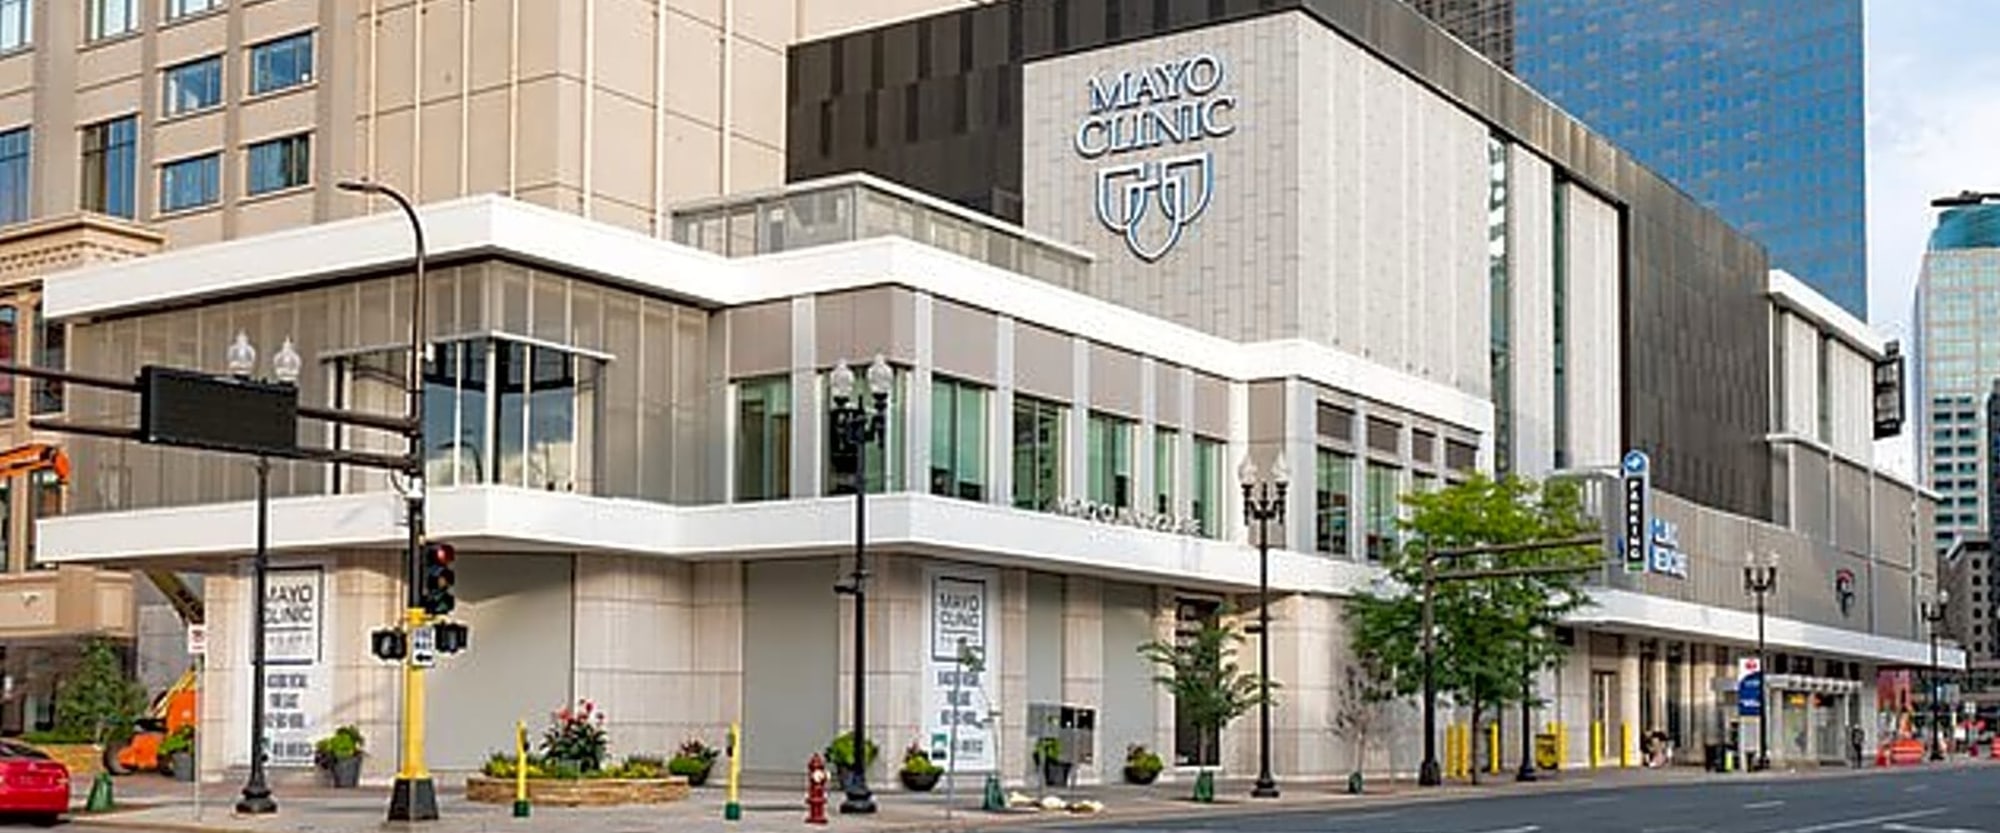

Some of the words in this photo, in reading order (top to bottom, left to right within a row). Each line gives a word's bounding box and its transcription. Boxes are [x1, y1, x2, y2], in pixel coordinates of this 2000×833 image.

[1088, 54, 1223, 114] MAYO
[1075, 95, 1236, 159] CLINIC
[1629, 481, 1641, 559] PARKING
[940, 592, 979, 611] MAYO
